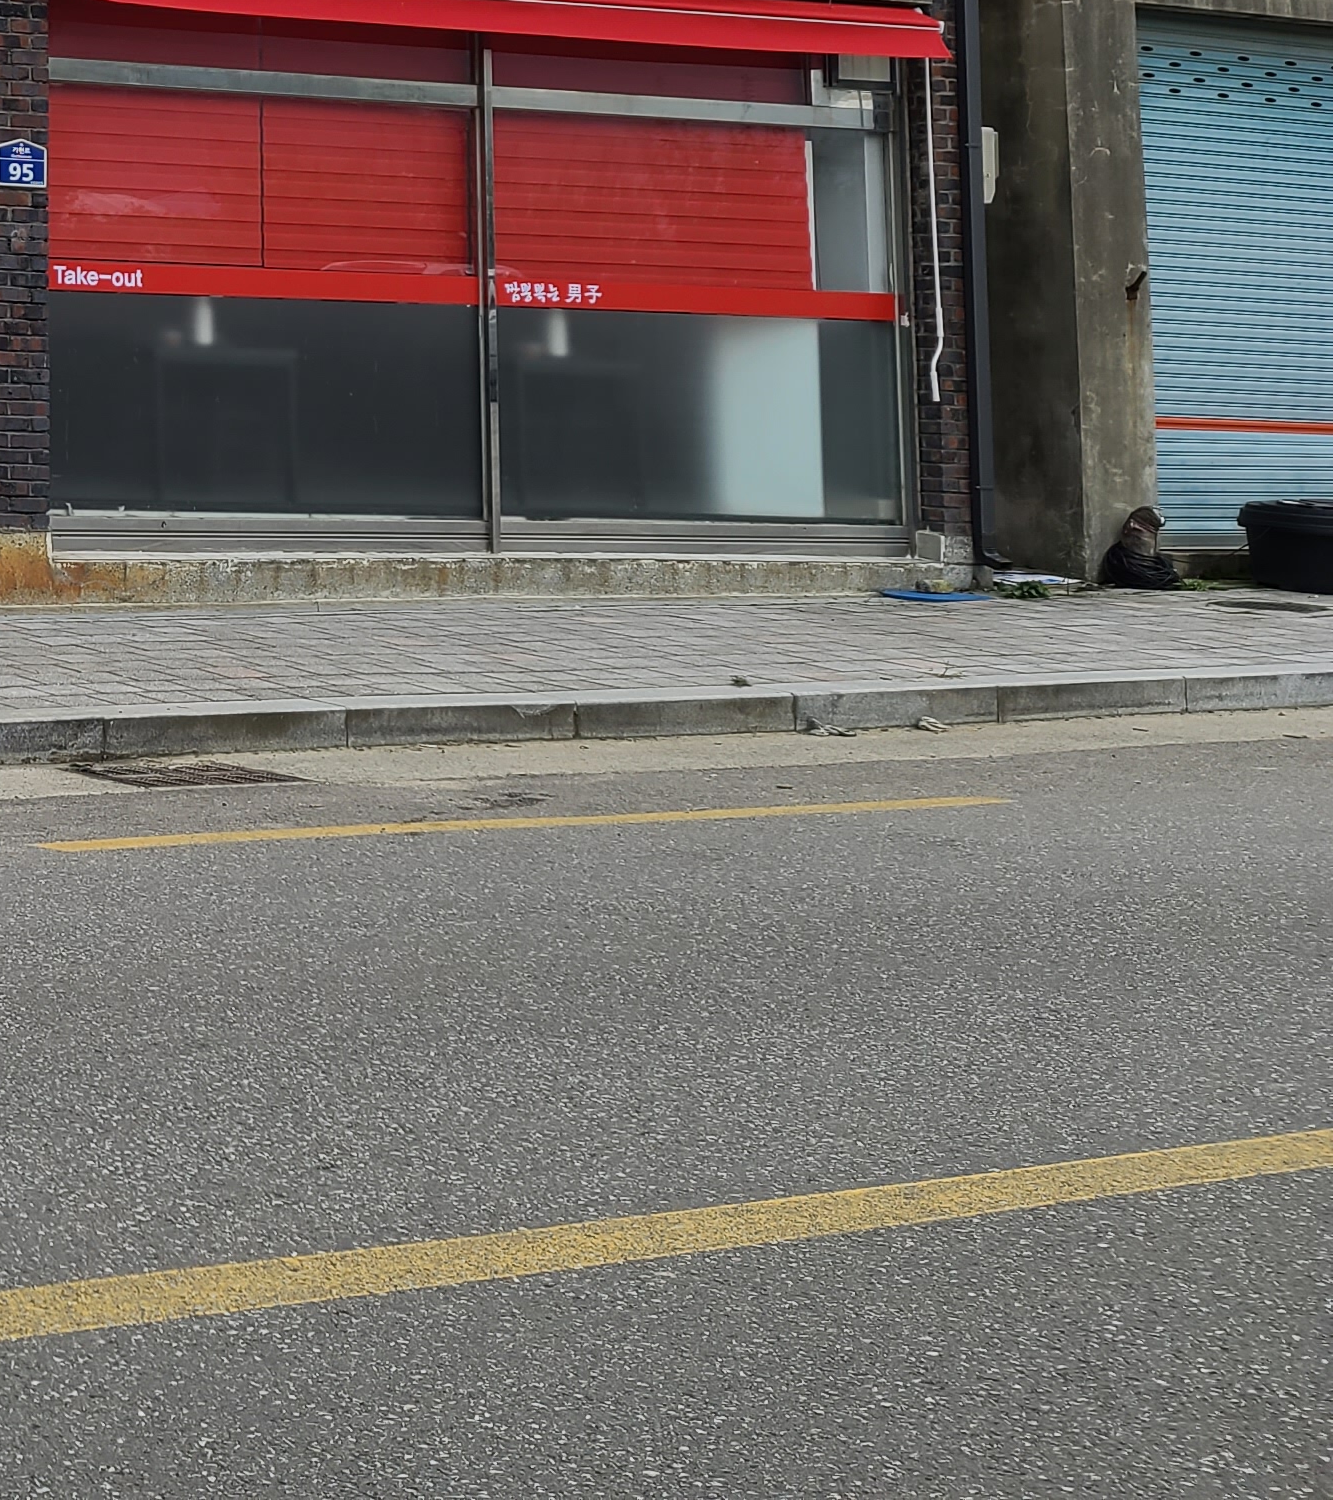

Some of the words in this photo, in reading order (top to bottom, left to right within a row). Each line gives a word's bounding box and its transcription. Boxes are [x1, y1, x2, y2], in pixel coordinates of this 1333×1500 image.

[9, 162, 34, 182] 95
[53, 265, 143, 288] Take-out
[564, 283, 603, 304] 男子
